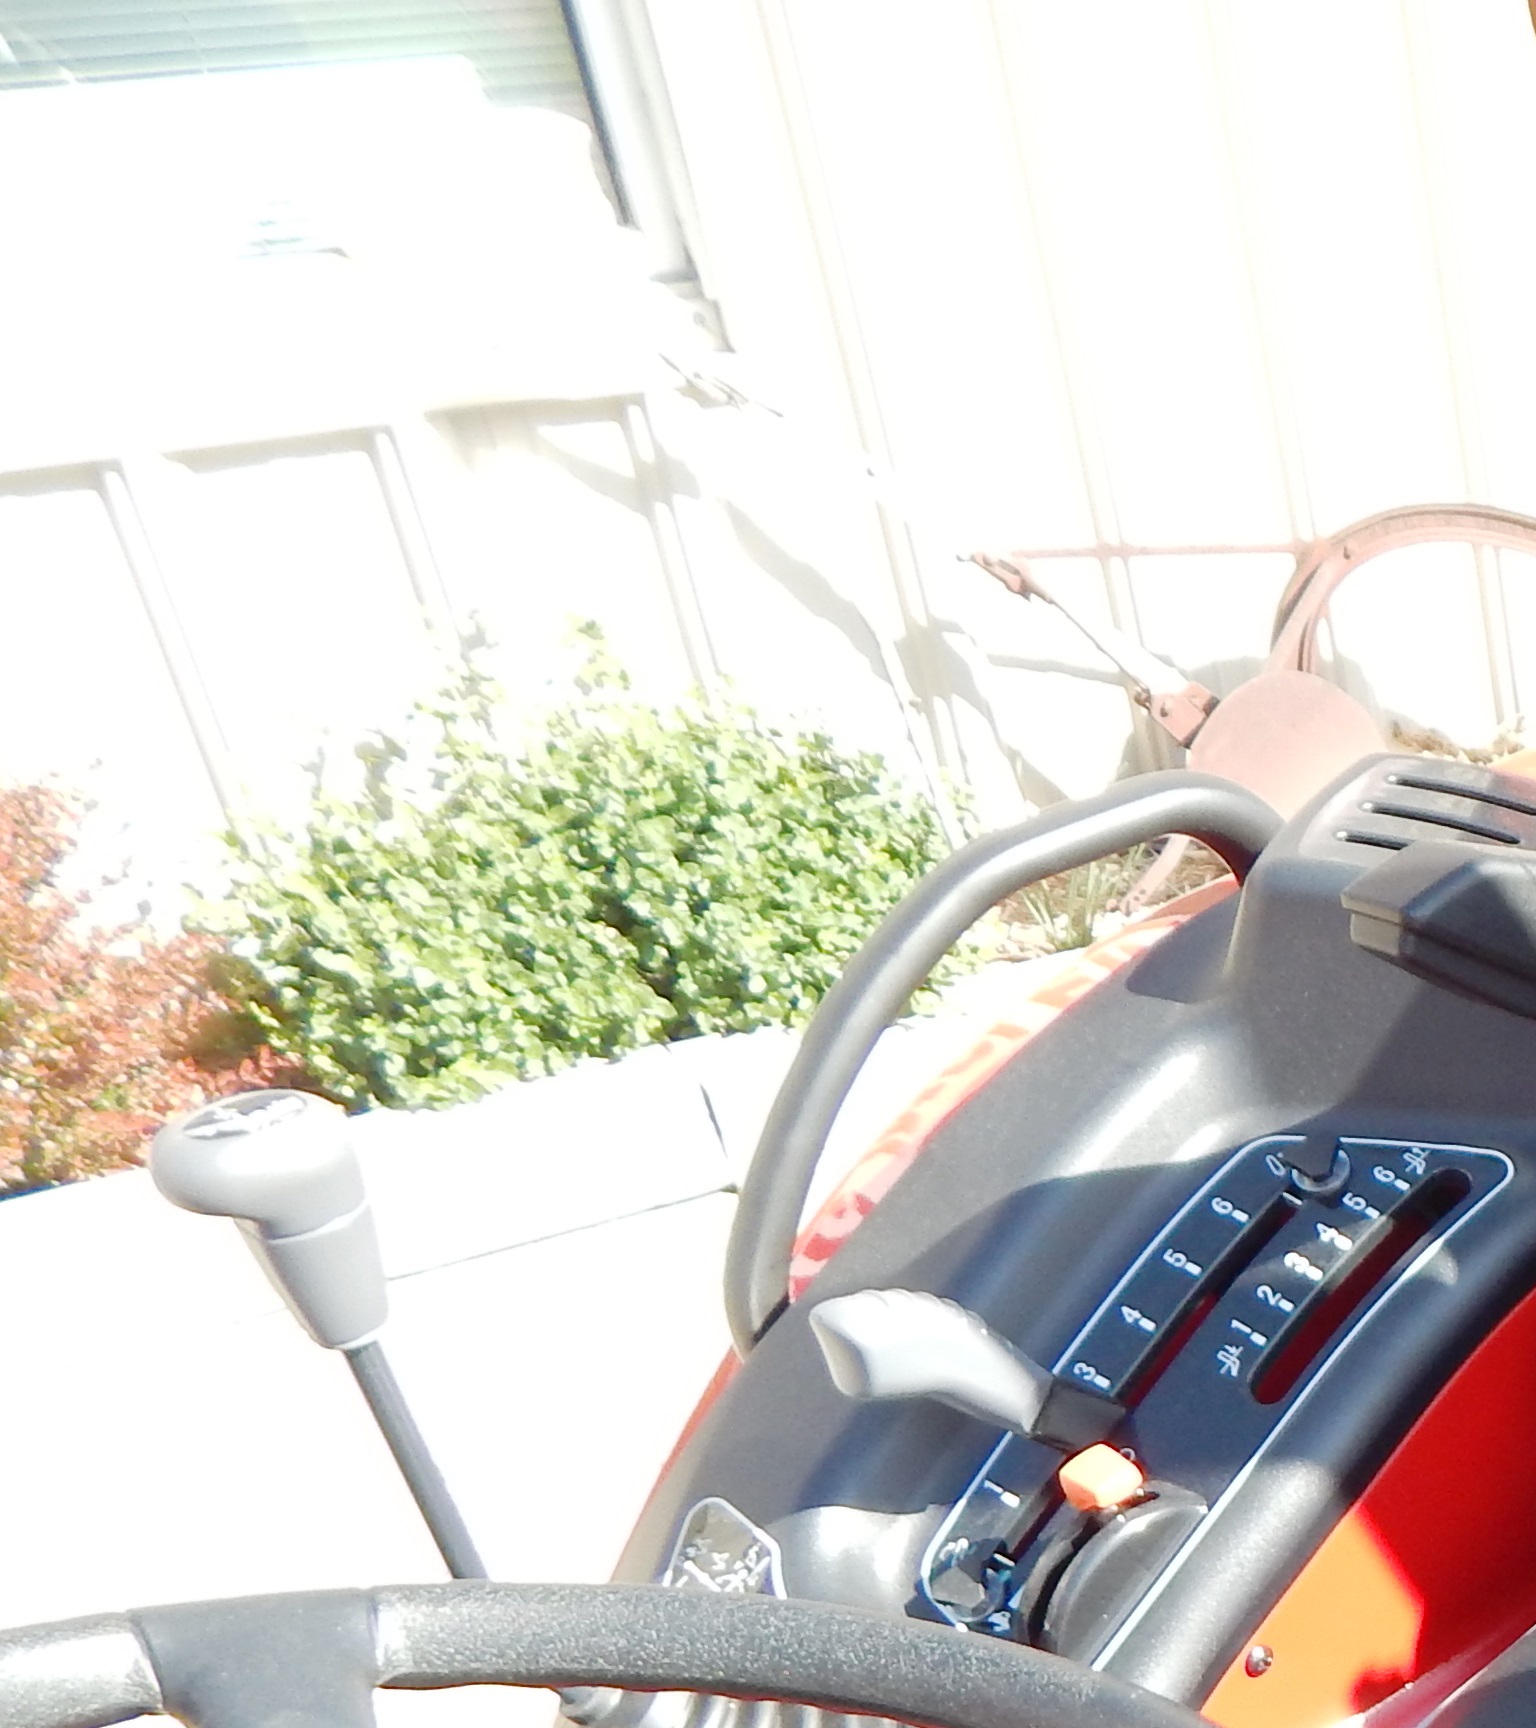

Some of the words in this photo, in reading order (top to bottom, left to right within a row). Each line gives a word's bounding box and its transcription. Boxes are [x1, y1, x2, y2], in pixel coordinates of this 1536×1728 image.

[1373, 1166, 1396, 1183] 6
[1211, 1197, 1234, 1215] 6
[1342, 1192, 1367, 1210] 5
[1316, 1223, 1339, 1242] 4
[1163, 1248, 1189, 1267] 5
[1283, 1251, 1310, 1273] 3
[1256, 1285, 1282, 1303] 2
[1120, 1304, 1143, 1324] 4
[1073, 1362, 1098, 1381] 3
